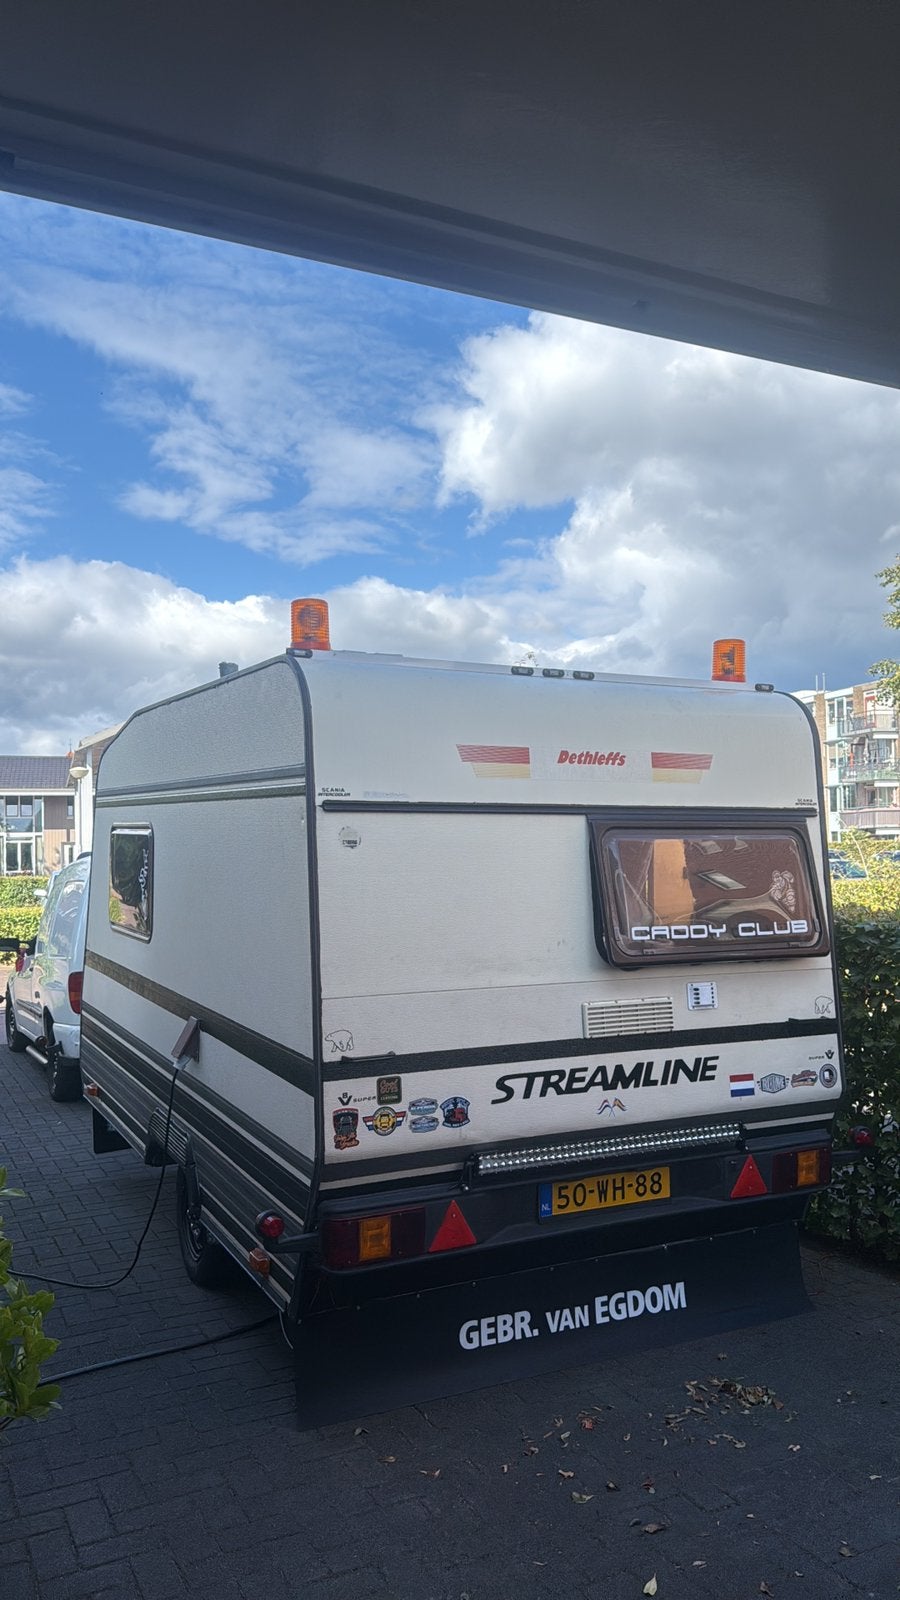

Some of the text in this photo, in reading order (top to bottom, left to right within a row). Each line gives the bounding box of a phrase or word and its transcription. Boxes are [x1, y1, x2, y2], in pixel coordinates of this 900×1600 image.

[557, 750, 626, 766] Dethleffs
[631, 919, 808, 941] CADDY CLUB
[490, 1055, 720, 1105] STREAMLINE
[353, 1095, 377, 1103] SUPER
[541, 1171, 663, 1211] NL 50-WH-88
[458, 1281, 688, 1351] GEBR. VAN EGDOM
